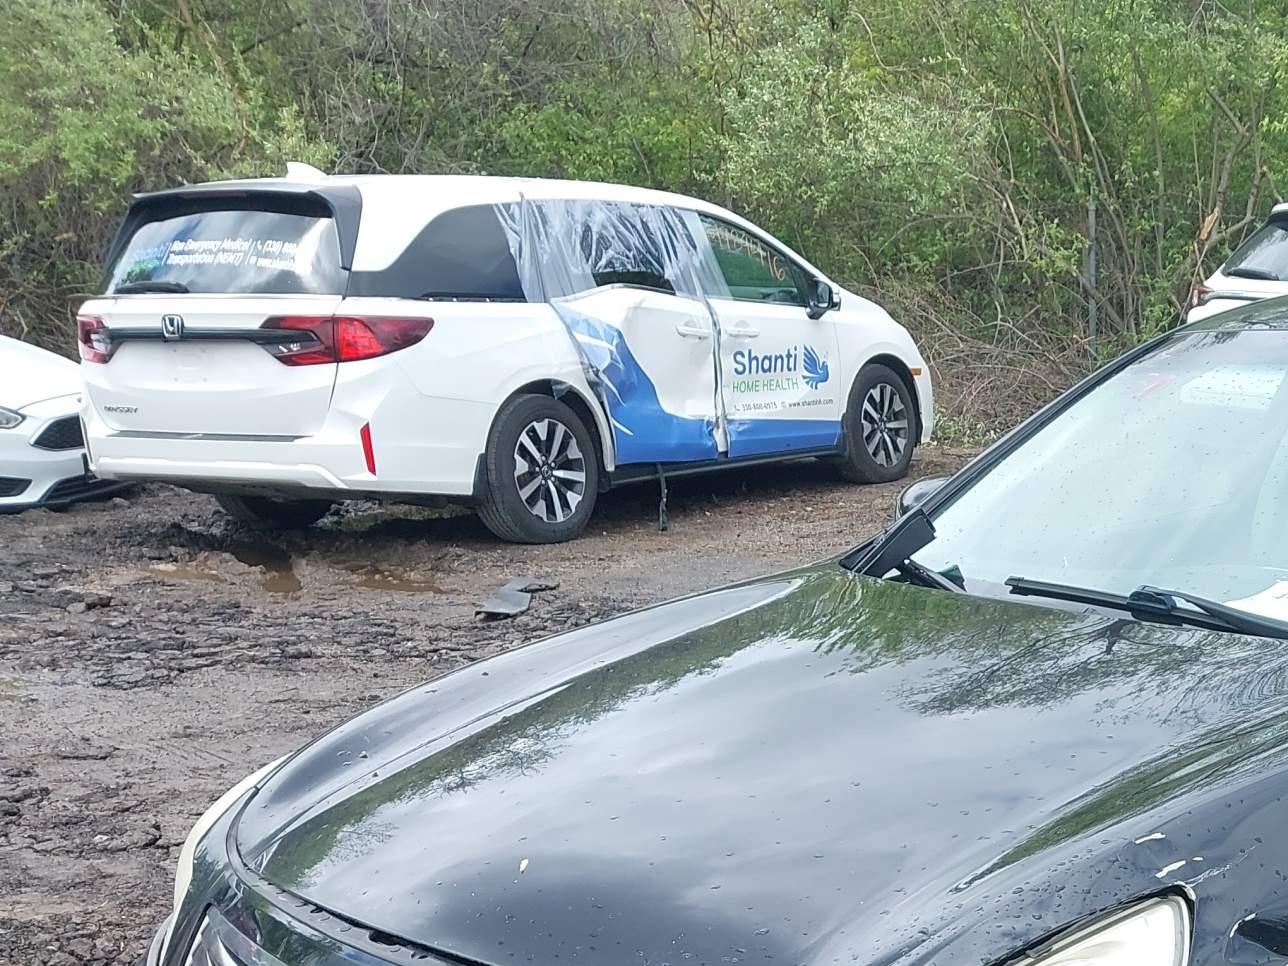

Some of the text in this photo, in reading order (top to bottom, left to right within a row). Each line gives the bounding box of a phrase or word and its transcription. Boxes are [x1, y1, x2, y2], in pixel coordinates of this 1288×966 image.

[733, 345, 798, 375] Shanti
[732, 378, 799, 393] HOME HEALTH
